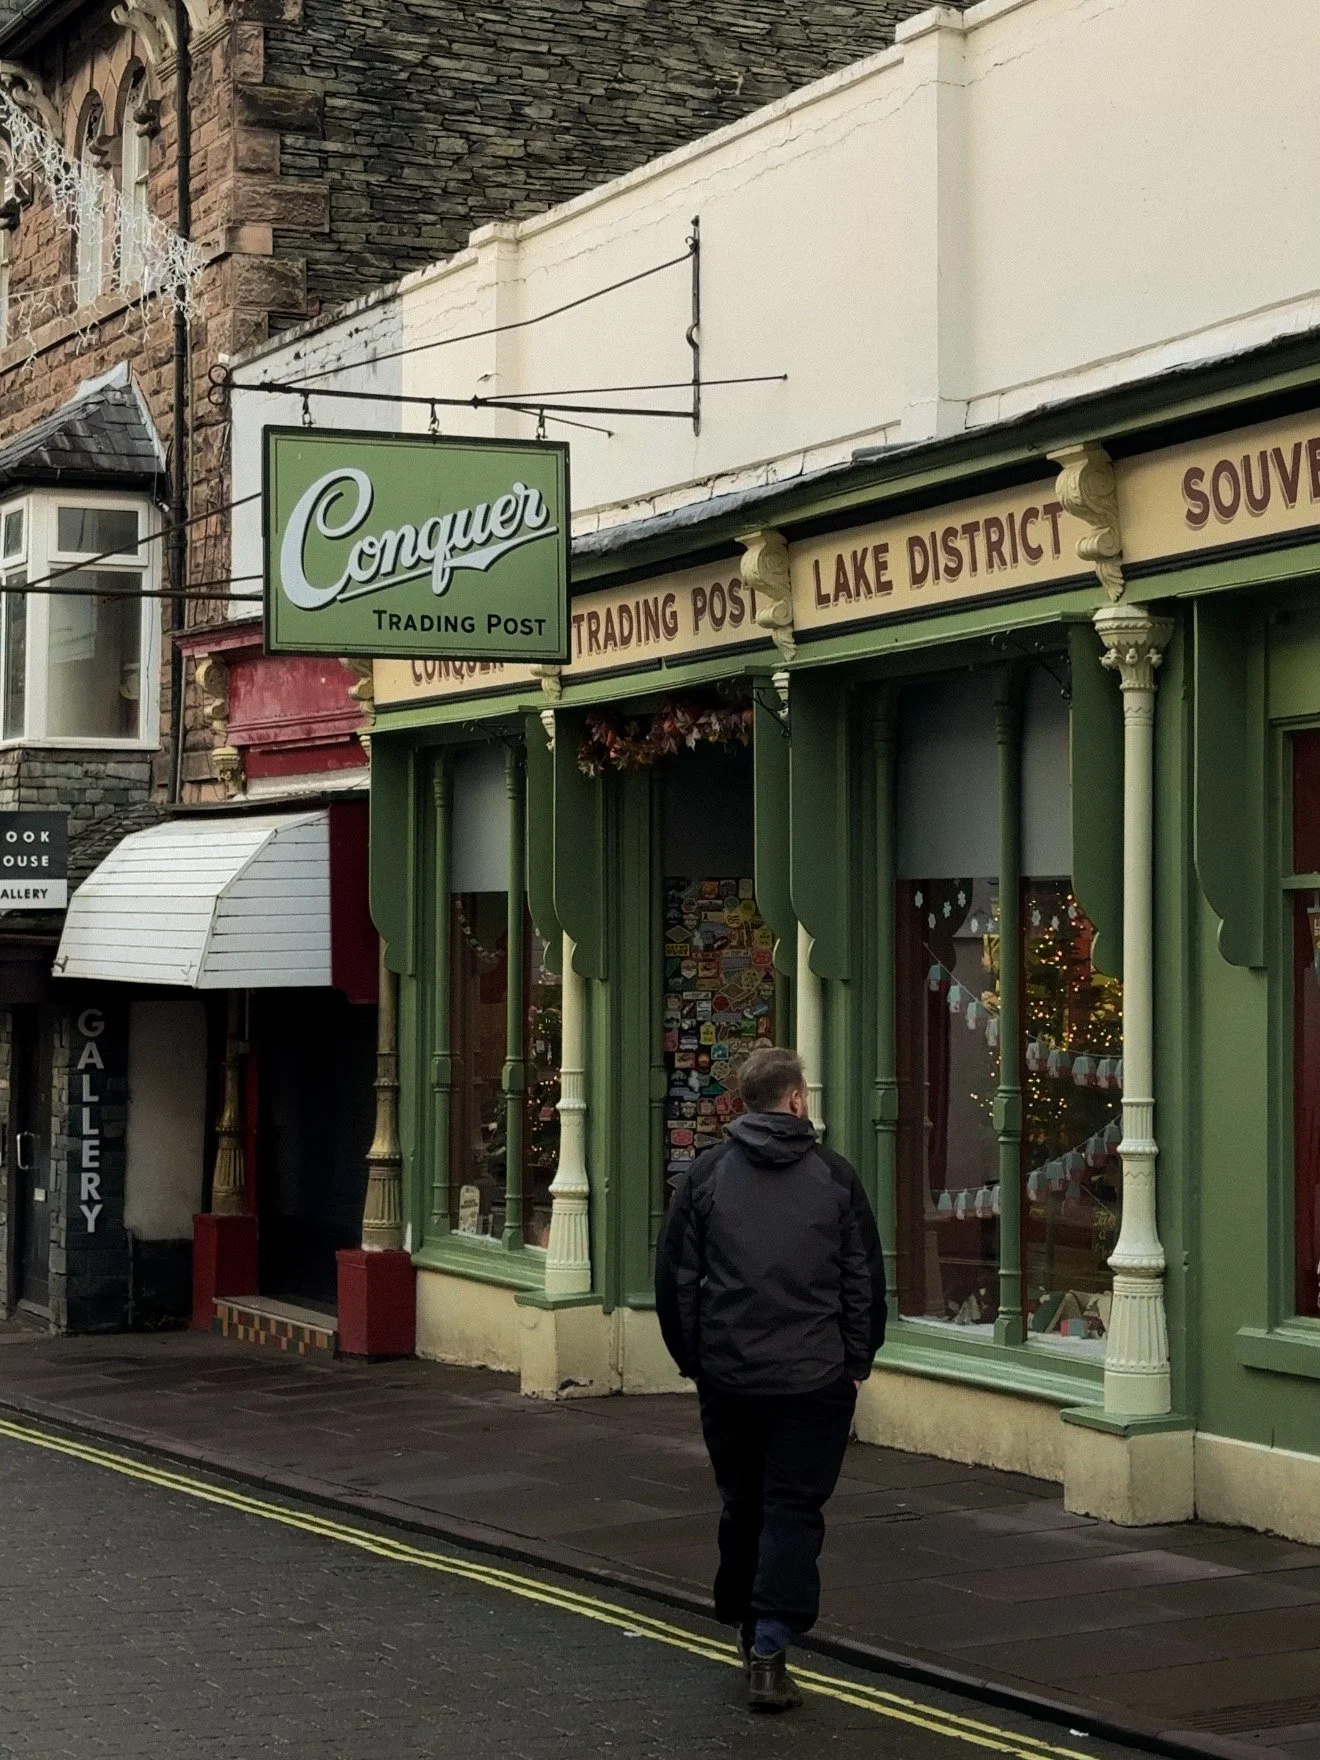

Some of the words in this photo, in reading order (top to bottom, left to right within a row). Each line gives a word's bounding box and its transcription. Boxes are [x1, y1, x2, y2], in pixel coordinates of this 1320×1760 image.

[279, 467, 548, 611] Conquer
[813, 543, 893, 609] LAKE
[906, 501, 1064, 590] DISTRICT
[572, 593, 679, 657] TRADING
[77, 1008, 105, 1233] GALLERY
